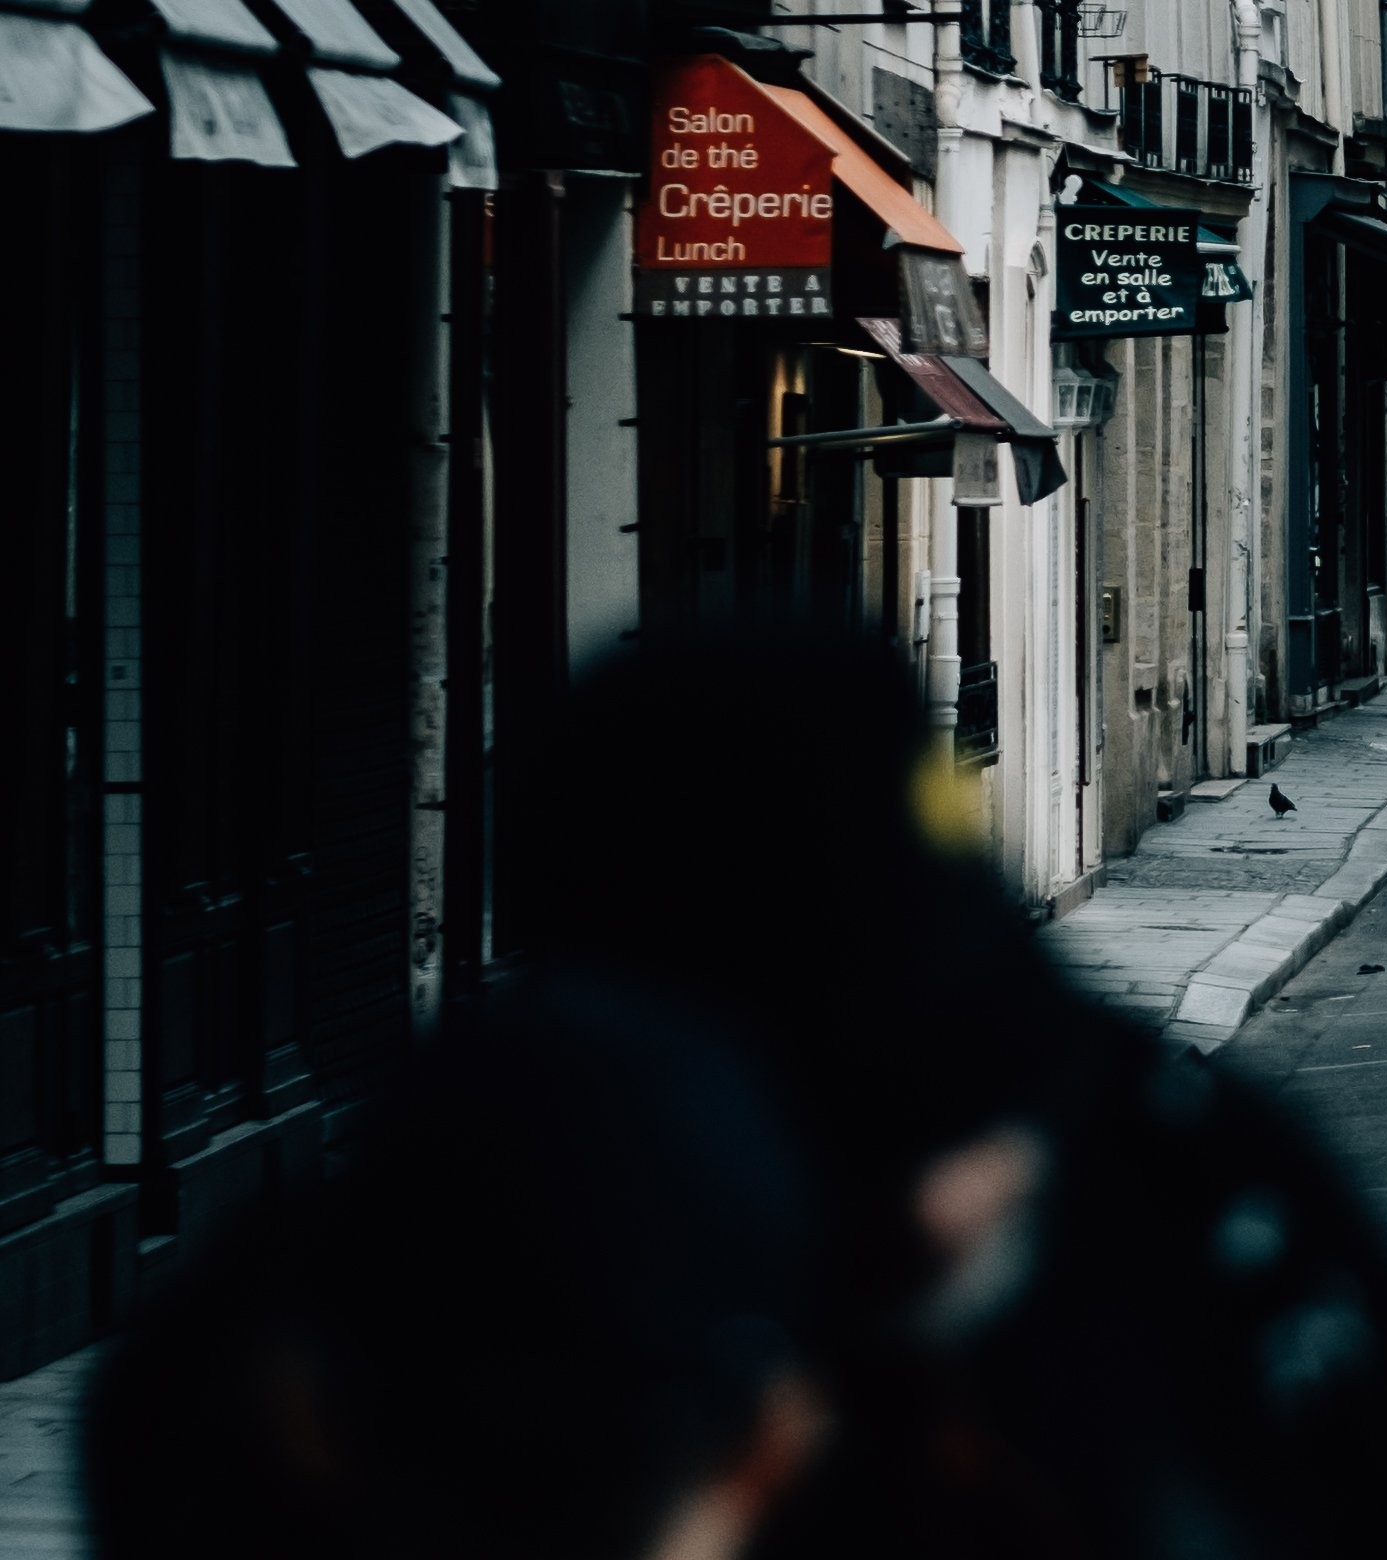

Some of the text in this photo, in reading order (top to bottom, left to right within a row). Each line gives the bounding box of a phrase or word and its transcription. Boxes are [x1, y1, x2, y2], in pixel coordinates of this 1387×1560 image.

[668, 106, 755, 133] Salon
[661, 142, 759, 169] de thé
[659, 183, 833, 227] Crêperie
[1064, 223, 1190, 243] CREPERIE
[657, 235, 746, 262] Lunch
[1091, 249, 1163, 268] Vente
[674, 274, 821, 294] VENTE A
[1081, 269, 1173, 286] en salle
[1102, 286, 1152, 304] et à
[652, 297, 831, 317] EMPORTER
[1069, 306, 1185, 326] emporter
